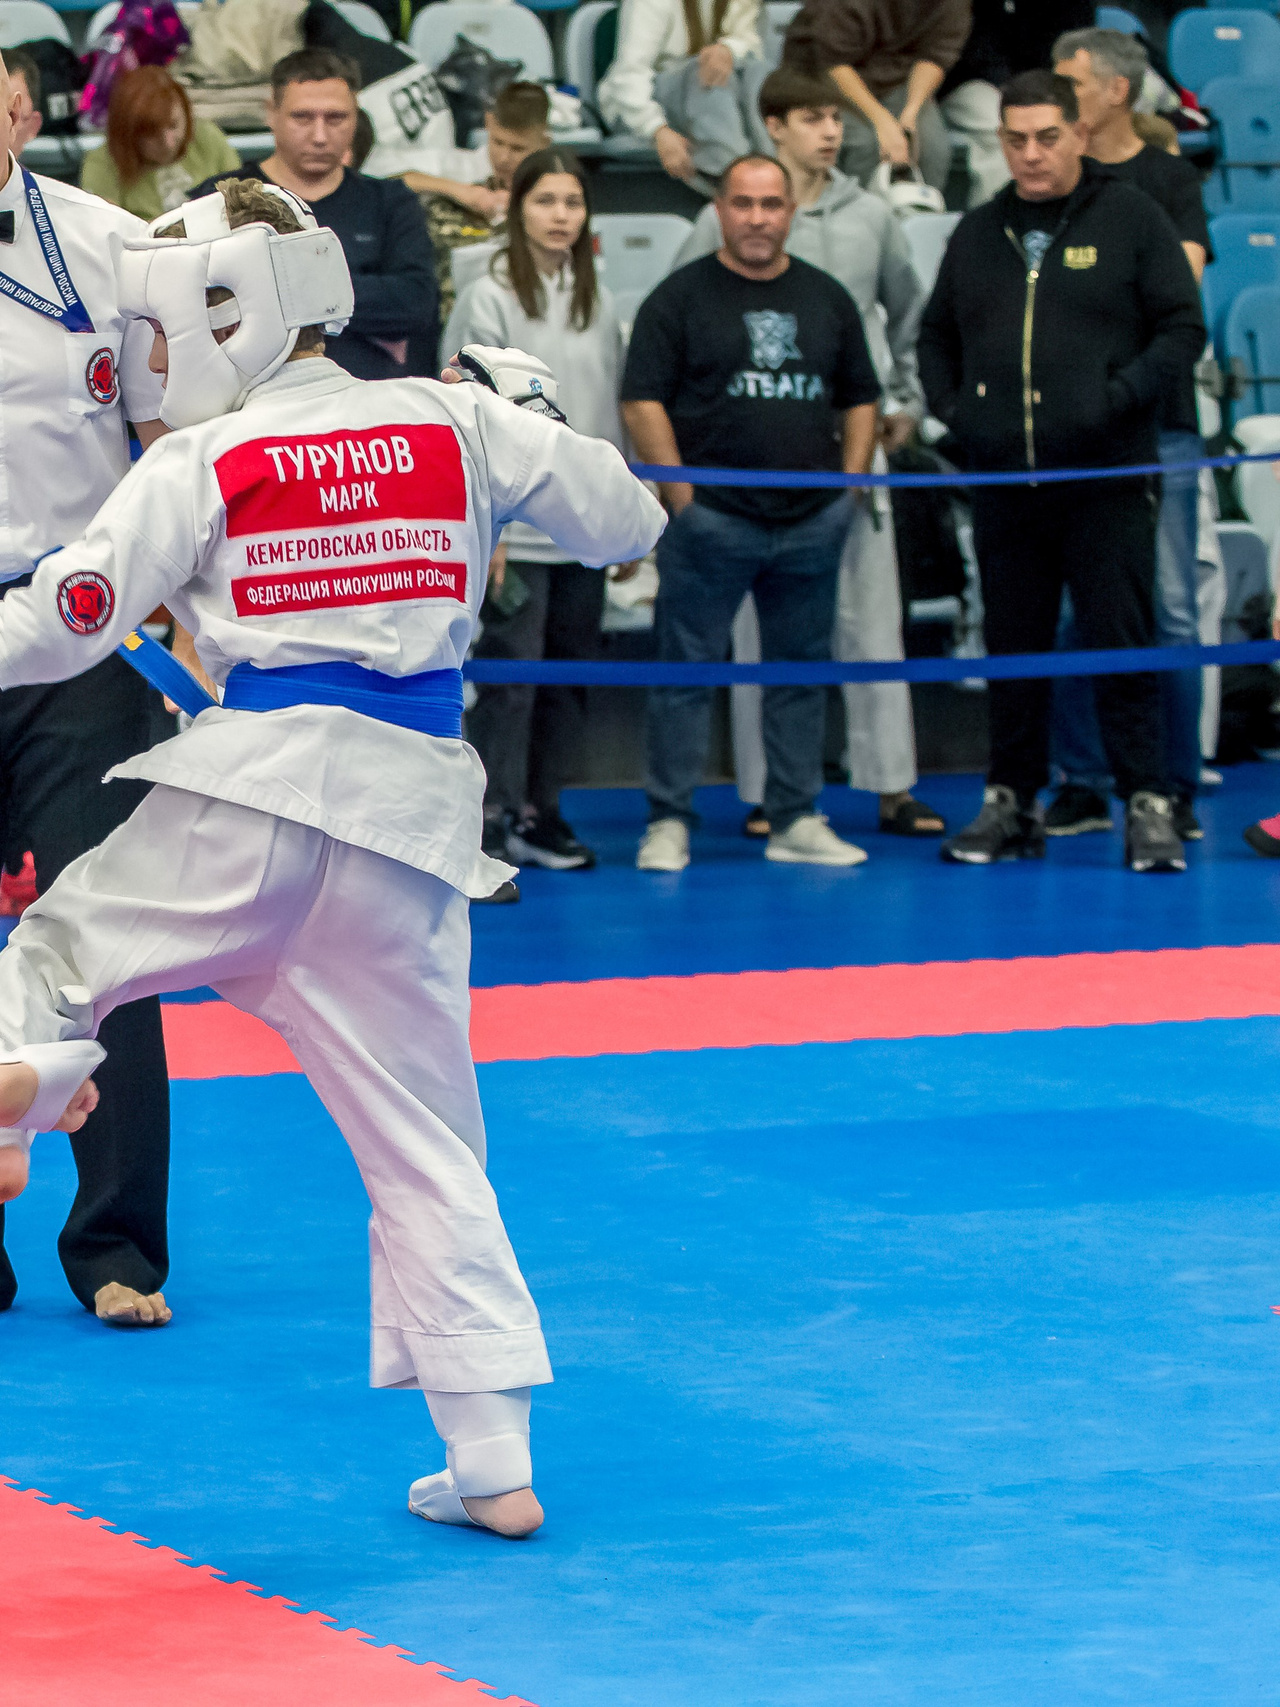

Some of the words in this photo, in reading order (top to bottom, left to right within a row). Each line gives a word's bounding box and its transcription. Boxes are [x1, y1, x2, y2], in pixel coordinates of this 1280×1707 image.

[28, 188, 46, 232] ФЕДЕРАЦИЯ
[42, 231, 64, 274] КИОКУШИН
[56, 272, 77, 306] РОССИИ
[14, 288, 63, 318] ФЕДЕРАЦИЯ
[264, 435, 415, 483] ТУРУНОВ
[319, 481, 380, 513] МАРК
[246, 531, 377, 566] КЕМЕРОВСКАЯ
[382, 528, 451, 552] ОБЛАСТЬ
[246, 579, 330, 606] ФЕДЕРАЦИЯ
[333, 572, 412, 597] КИОКУШИН
